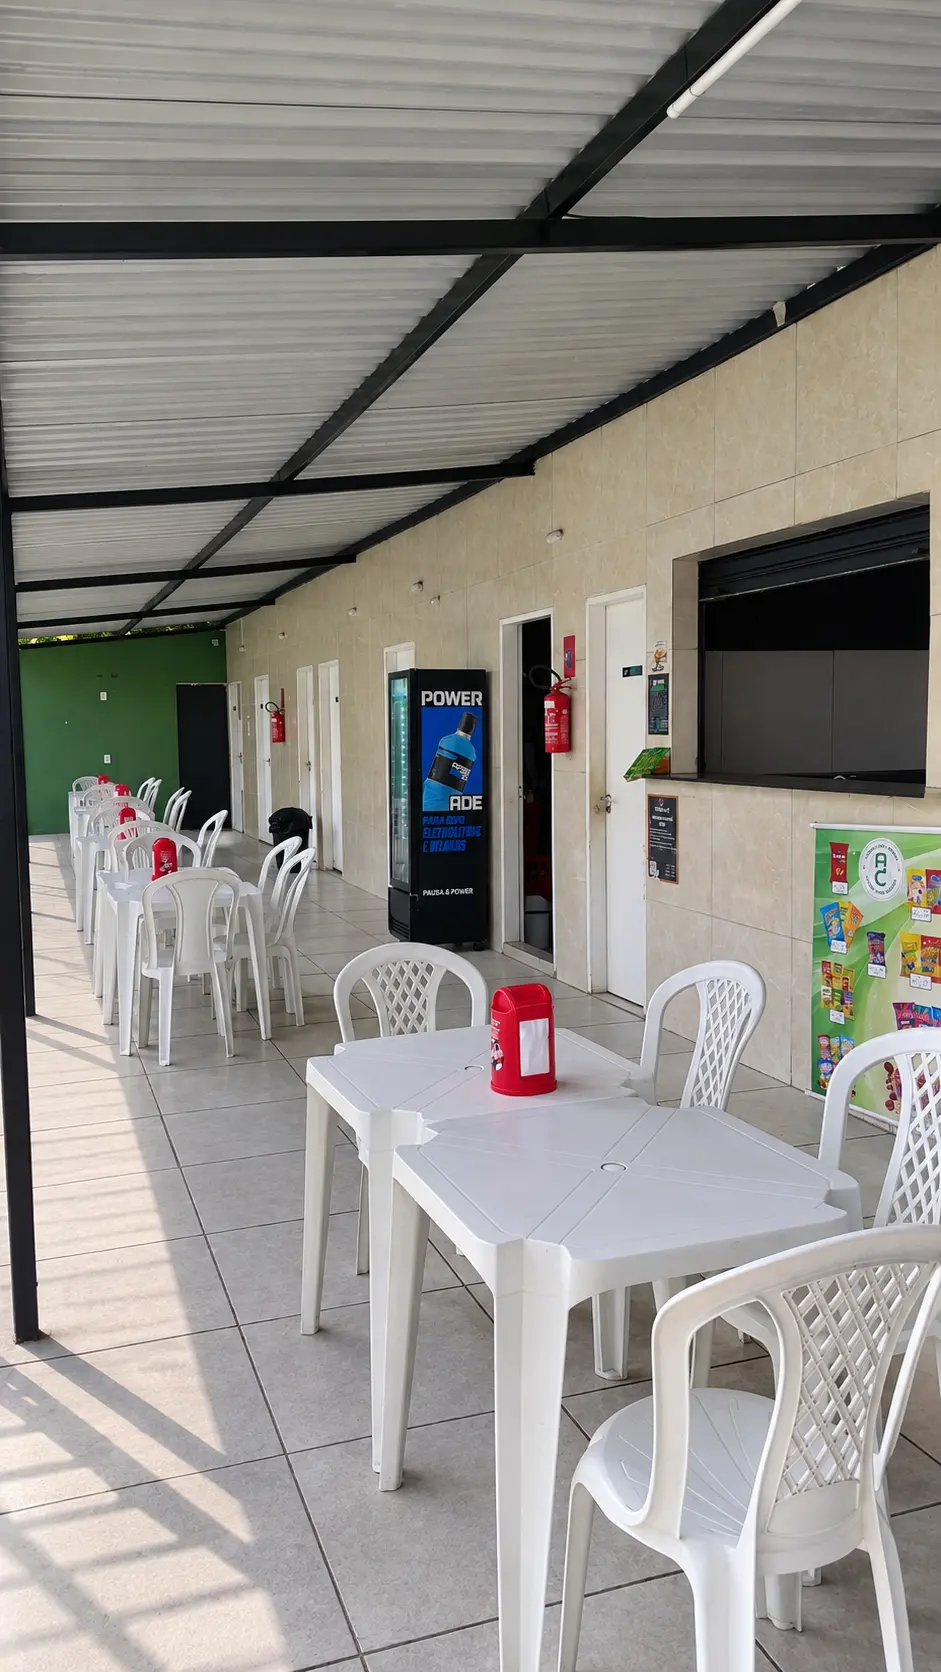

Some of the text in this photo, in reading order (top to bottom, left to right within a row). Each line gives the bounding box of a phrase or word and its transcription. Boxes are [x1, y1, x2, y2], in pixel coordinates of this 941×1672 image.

[421, 690, 483, 707] POWER
[449, 795, 483, 811] ADE
[422, 889, 445, 897] PAUSA
[450, 887, 474, 895] POWER
